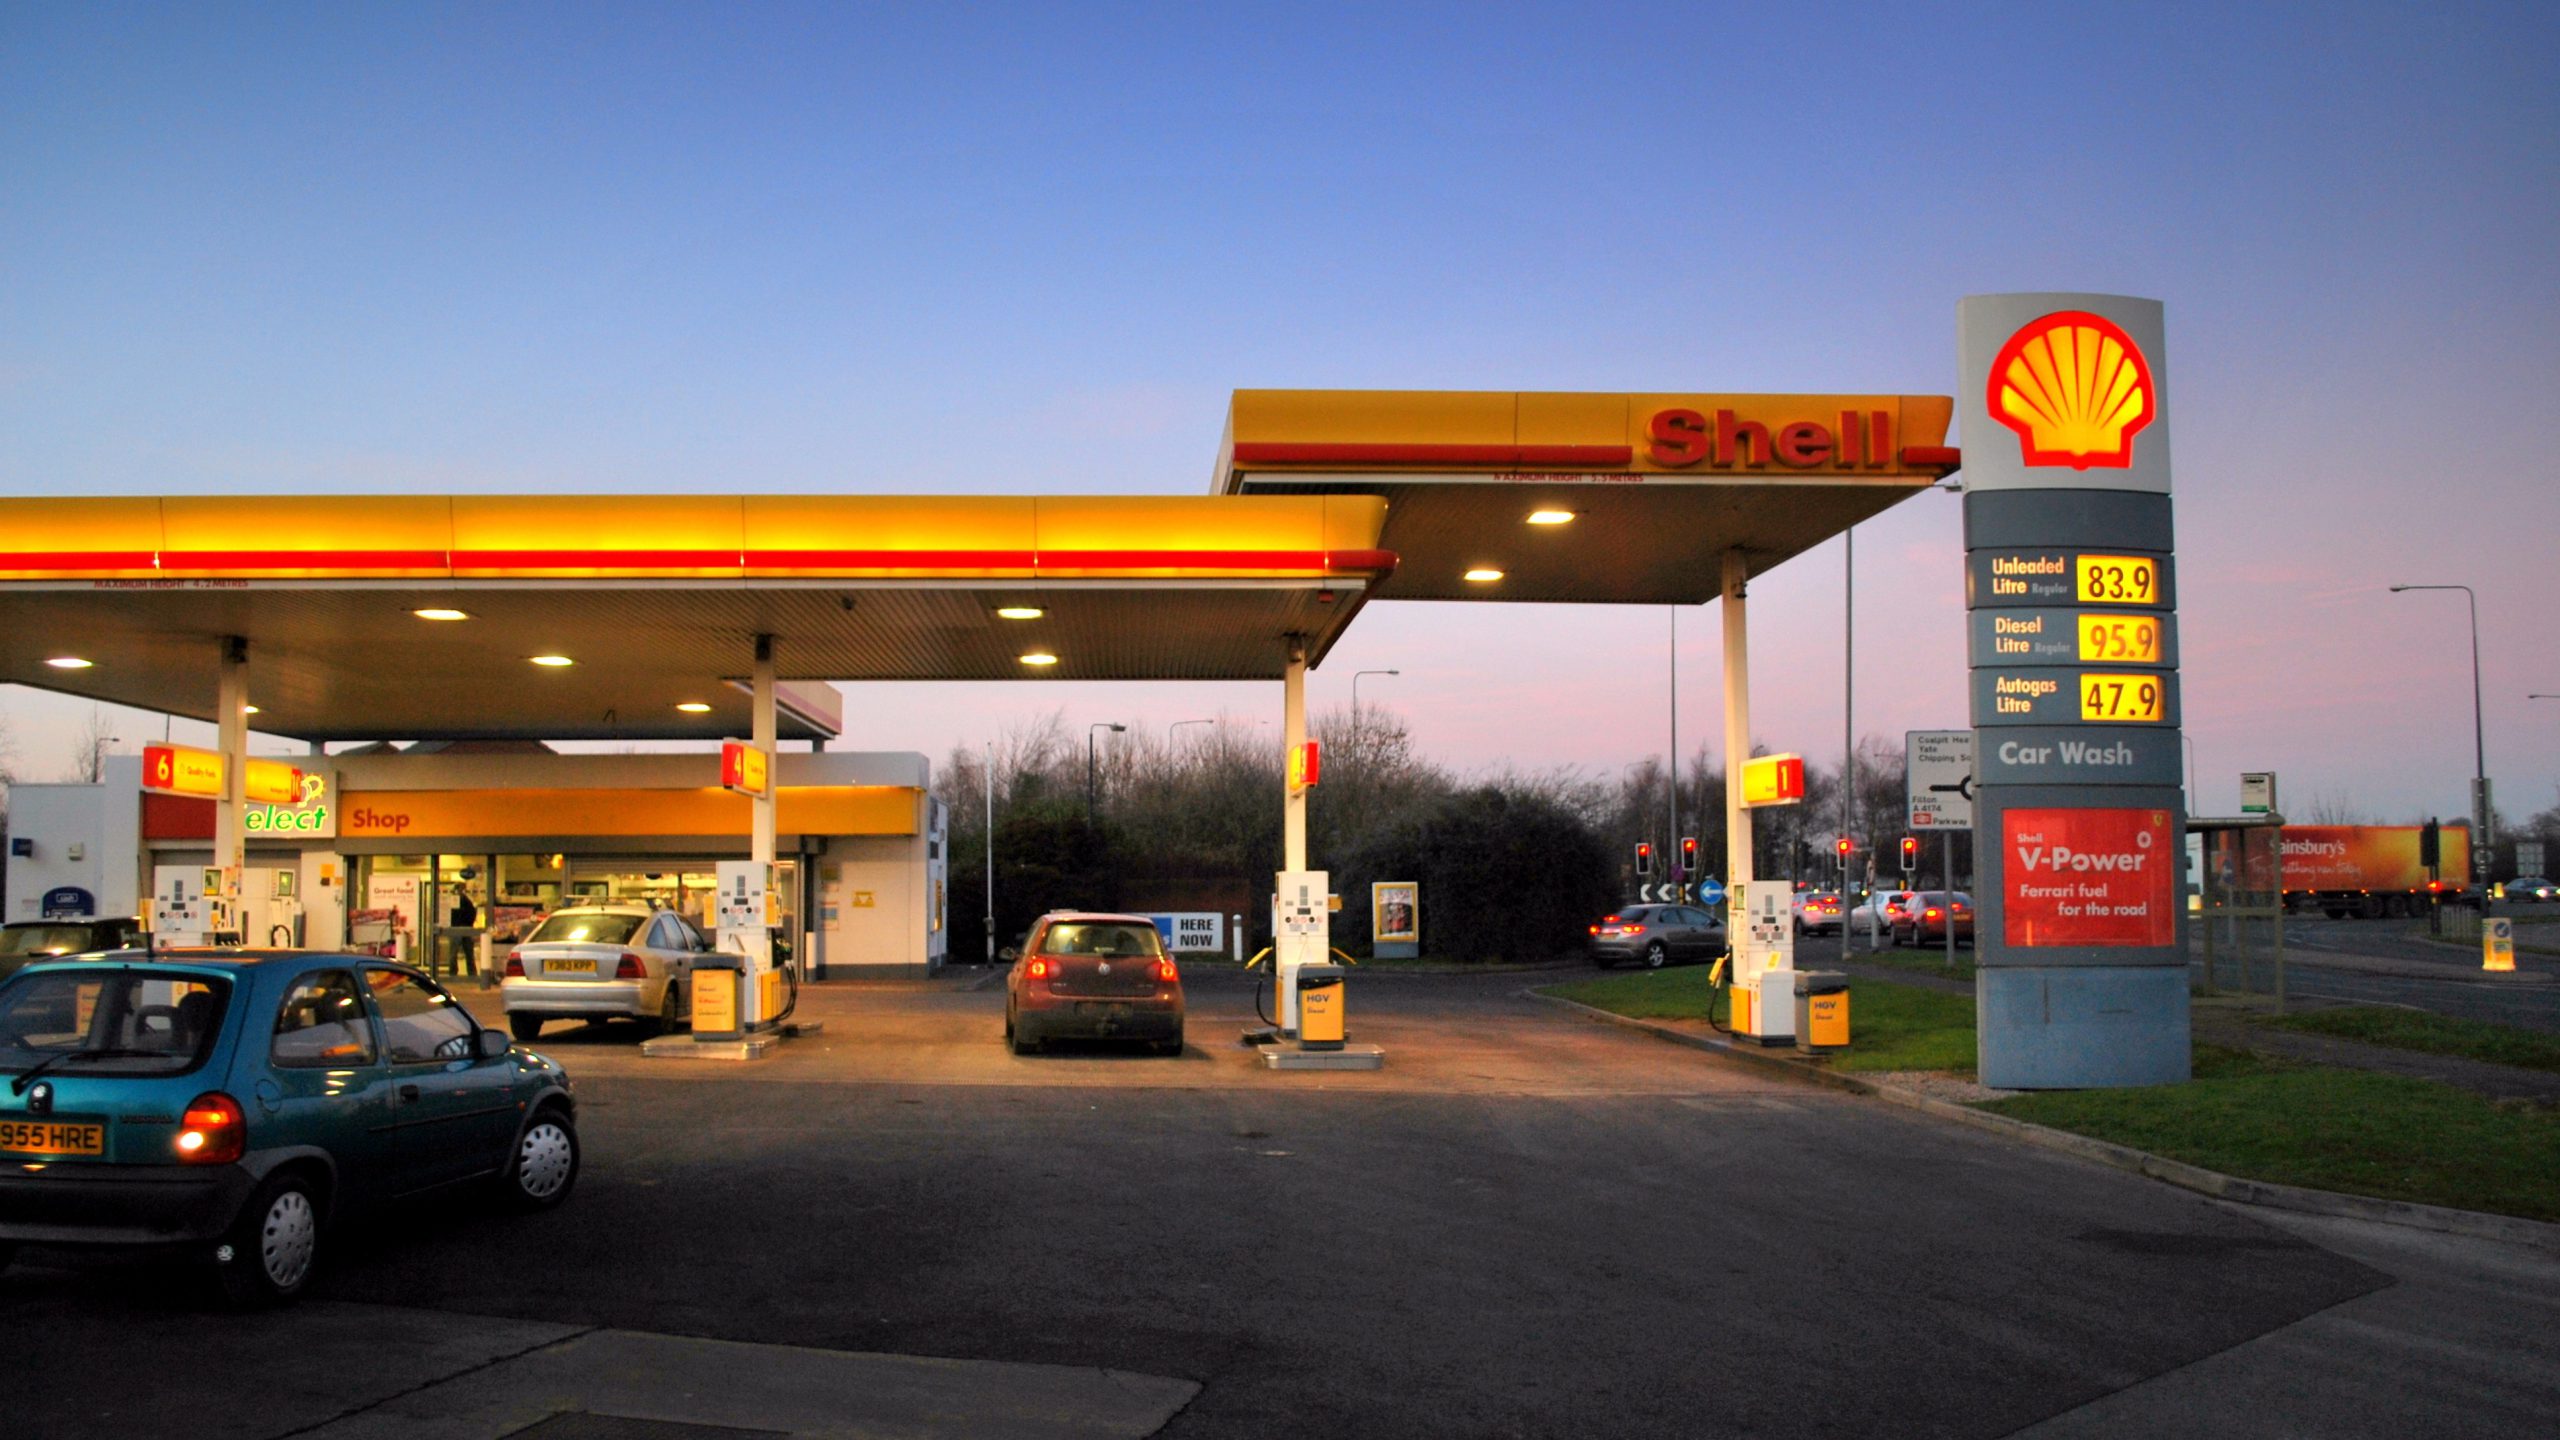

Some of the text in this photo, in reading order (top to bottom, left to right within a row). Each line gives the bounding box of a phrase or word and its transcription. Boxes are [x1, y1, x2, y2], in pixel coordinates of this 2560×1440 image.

[1644, 408, 1891, 469] Shell
[1549, 474, 1583, 482] HEIGHT
[150, 580, 185, 588] HEIGHT
[1992, 556, 2151, 598] Unleaded 83.9
[1993, 578, 2067, 597] Litre Regular
[1995, 616, 2154, 658] Diesel 95.9
[1996, 637, 2071, 655] Litre Regular
[1996, 676, 2156, 716] Autogas 47.9
[1997, 697, 2032, 713] Litre
[1918, 755, 1955, 763] Chipping
[1999, 741, 2133, 765] Car Wash
[157, 755, 170, 781] 6
[734, 752, 742, 777] 4
[1781, 765, 1788, 791] 1
[244, 804, 328, 832] elect
[353, 807, 410, 833] Shop
[1934, 817, 1967, 826] Parkway
[2017, 833, 2043, 843] Shell
[2018, 846, 2146, 871] V-Power
[2020, 883, 2108, 898] Ferrari fuel
[2058, 902, 2147, 916] for the road
[1180, 919, 1213, 931] HERE
[1180, 934, 1213, 946] NOW
[1306, 994, 1330, 1003] HGV
[1814, 1001, 1837, 1009] HGV
[1, 1125, 98, 1149] 955 HRE
